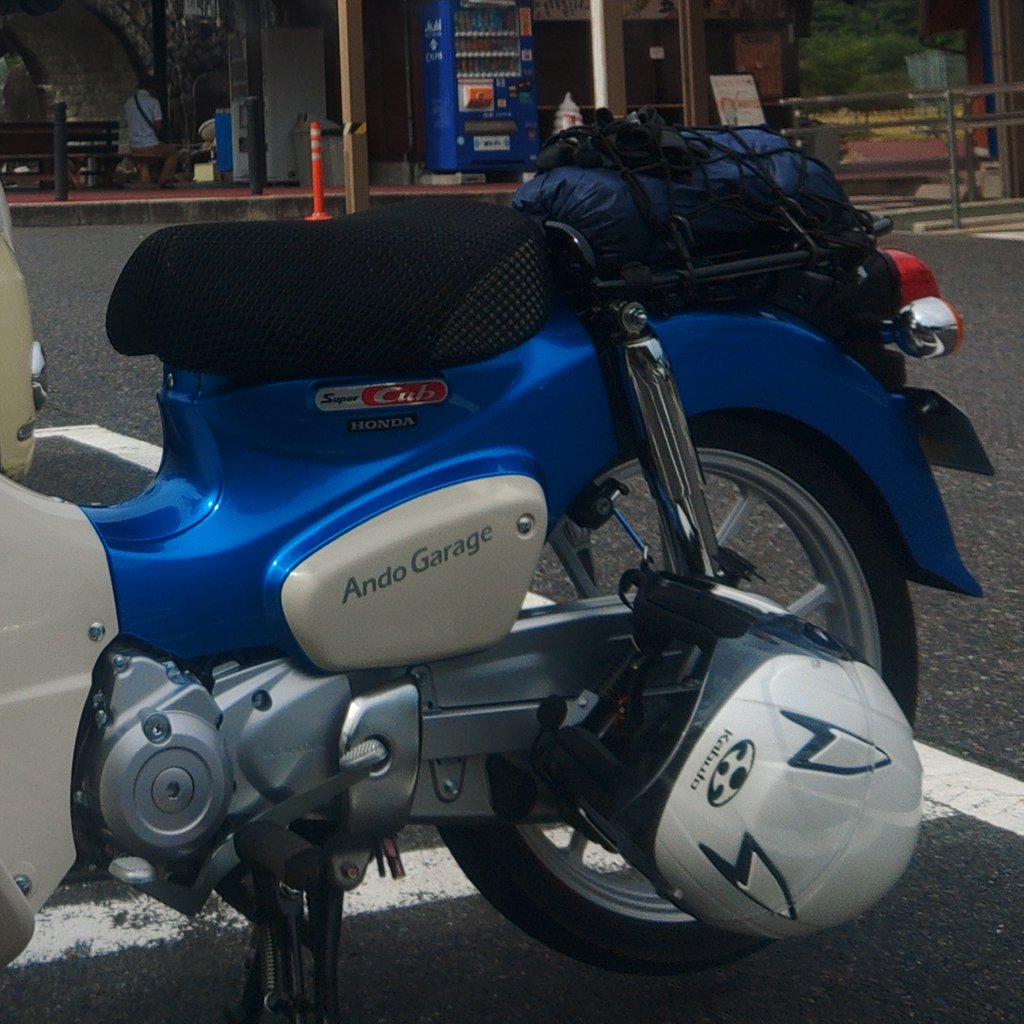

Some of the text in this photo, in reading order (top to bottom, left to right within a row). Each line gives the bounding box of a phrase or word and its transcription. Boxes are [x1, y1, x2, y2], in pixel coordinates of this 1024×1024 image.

[319, 383, 436, 405] Super Cub
[351, 416, 415, 431] HONDA
[342, 524, 493, 604] Ando Garage
[690, 730, 733, 790] Kabuto
